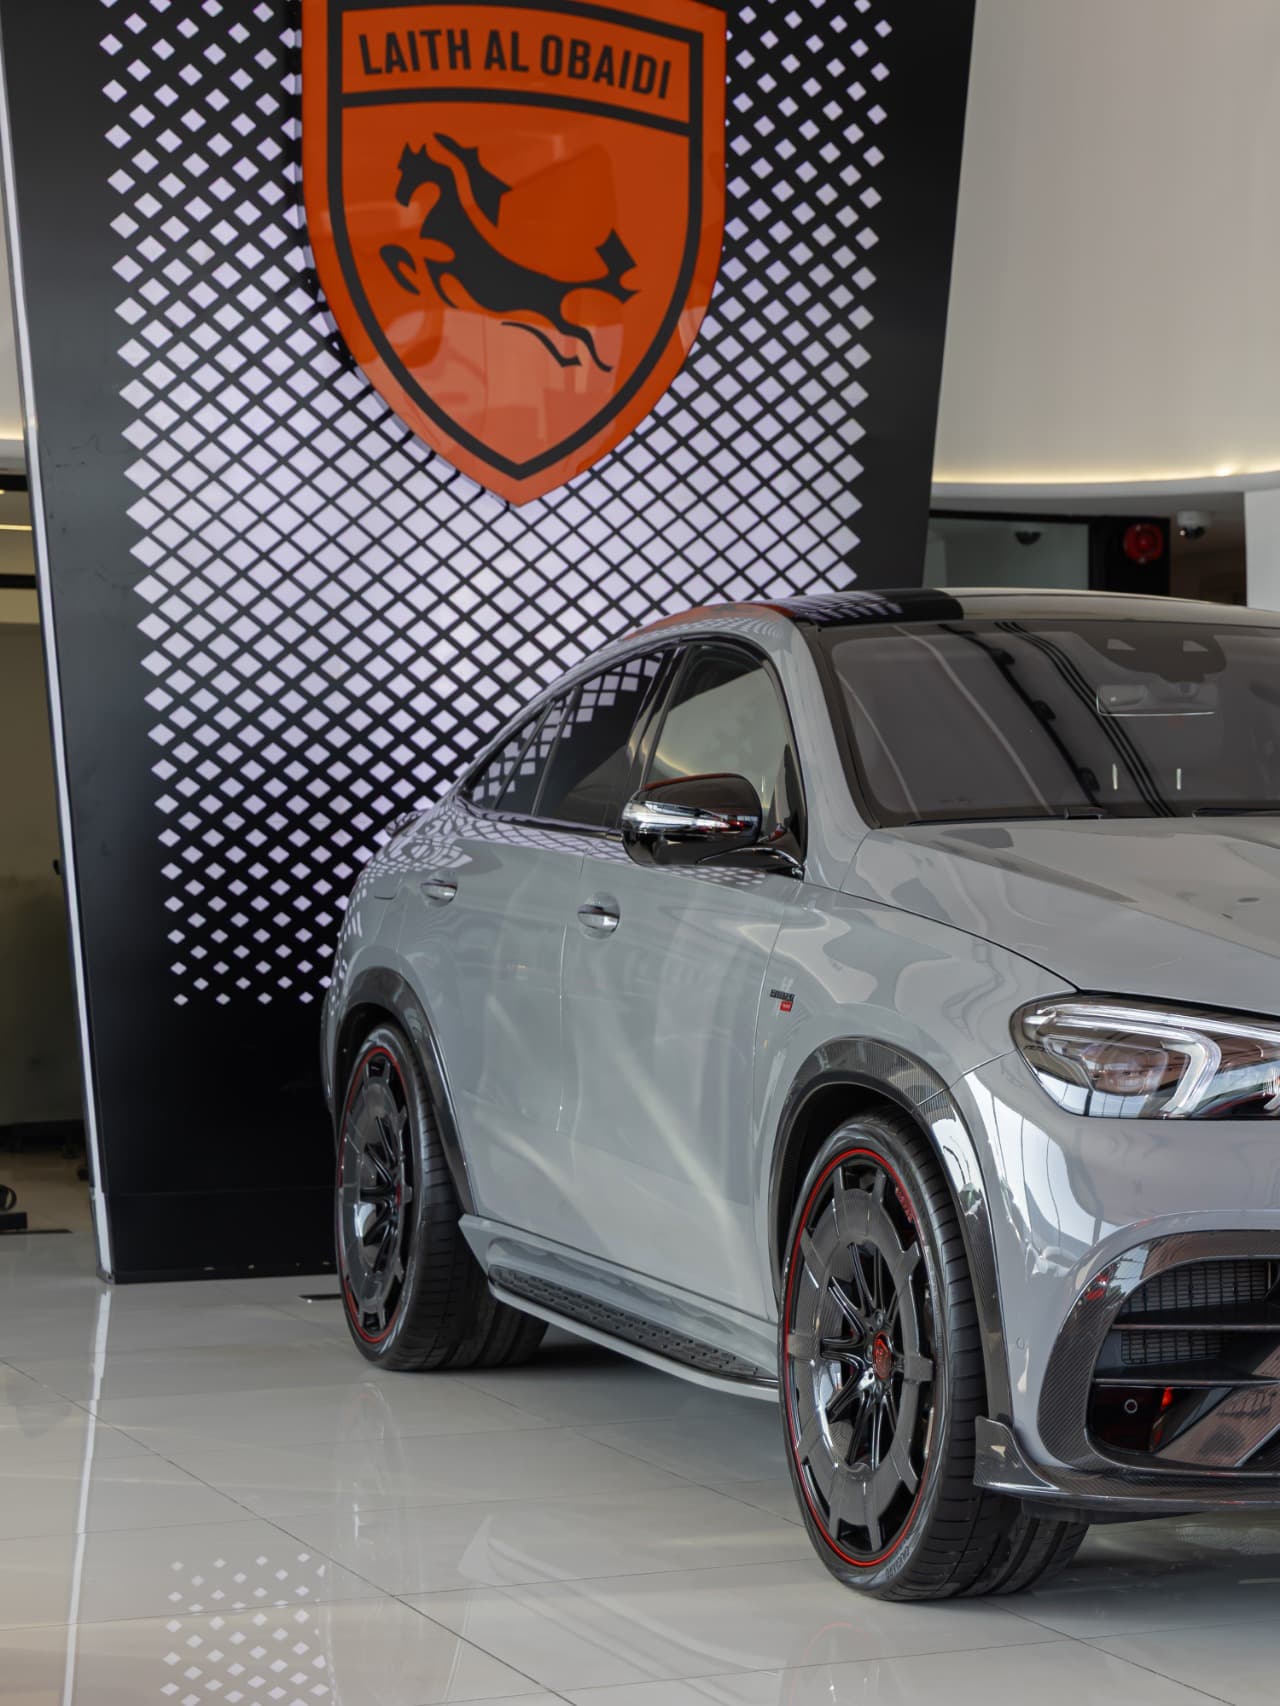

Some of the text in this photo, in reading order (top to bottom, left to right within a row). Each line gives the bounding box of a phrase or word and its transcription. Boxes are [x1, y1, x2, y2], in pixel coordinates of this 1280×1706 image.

[358, 28, 673, 100] LAITH AL OBAIDI
